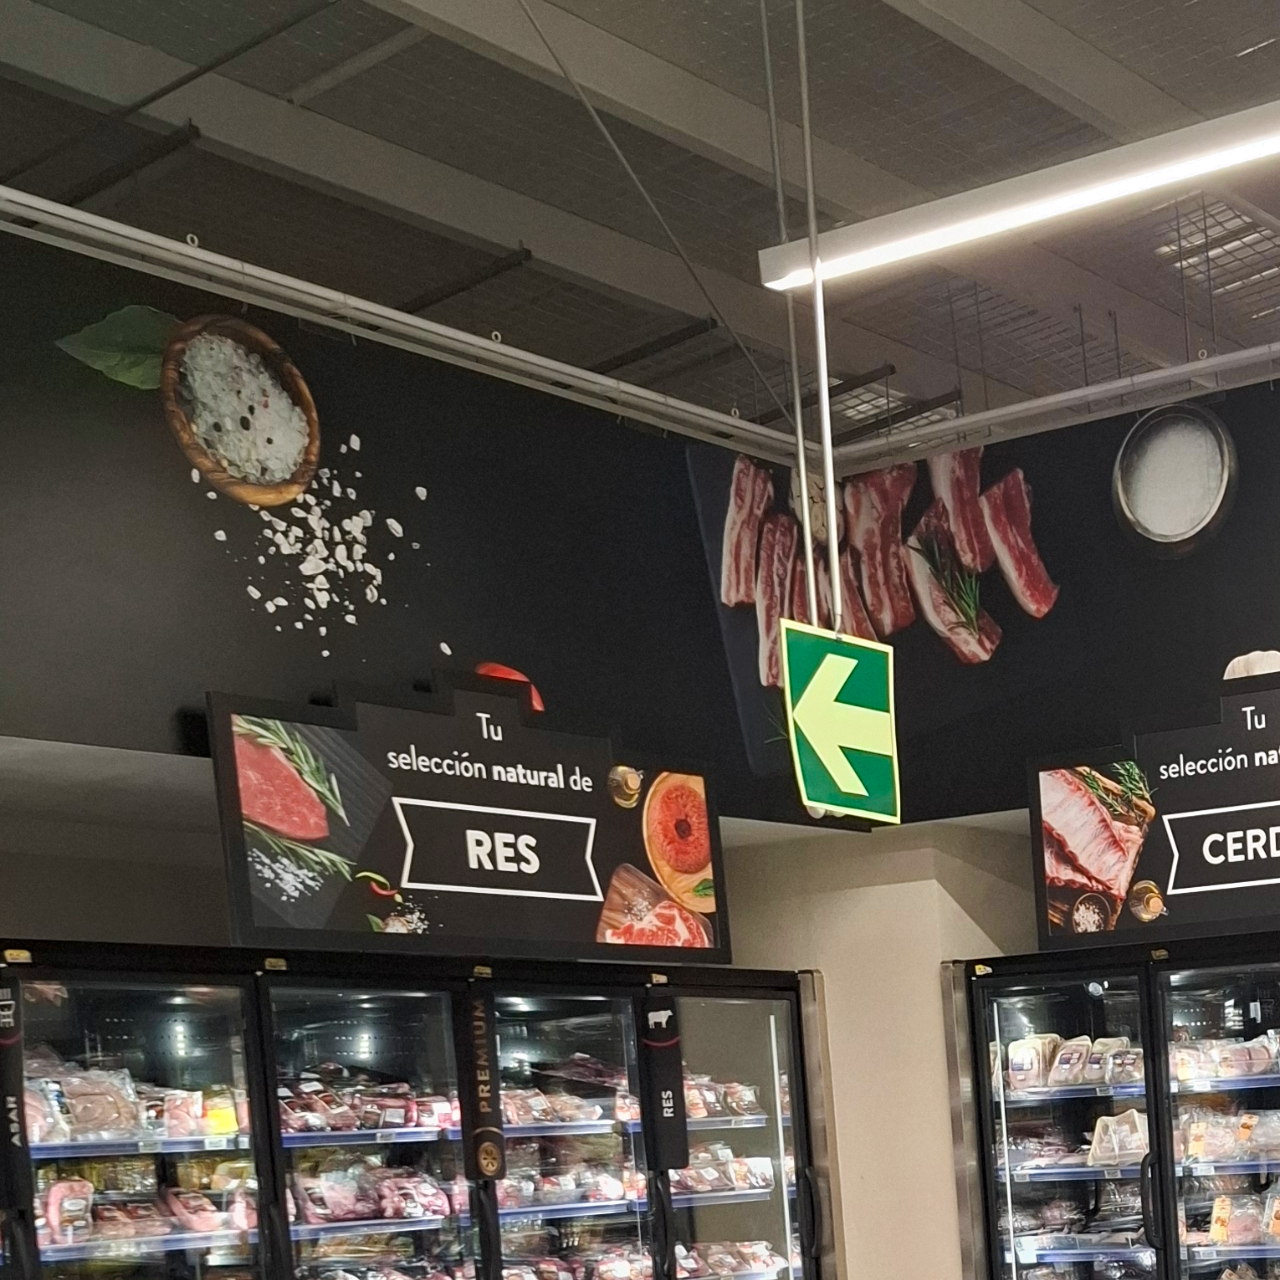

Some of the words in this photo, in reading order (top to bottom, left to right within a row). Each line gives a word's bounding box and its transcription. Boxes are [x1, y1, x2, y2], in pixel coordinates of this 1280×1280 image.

[475, 712, 503, 741] Tu
[1241, 706, 1266, 730] Tu
[387, 744, 487, 779] selección
[492, 763, 565, 789] natural
[569, 766, 593, 792] de
[1159, 747, 1249, 779] selección
[465, 829, 541, 874] RES
[472, 1000, 492, 1113] PREMIUM
[661, 1090, 675, 1118] RES
